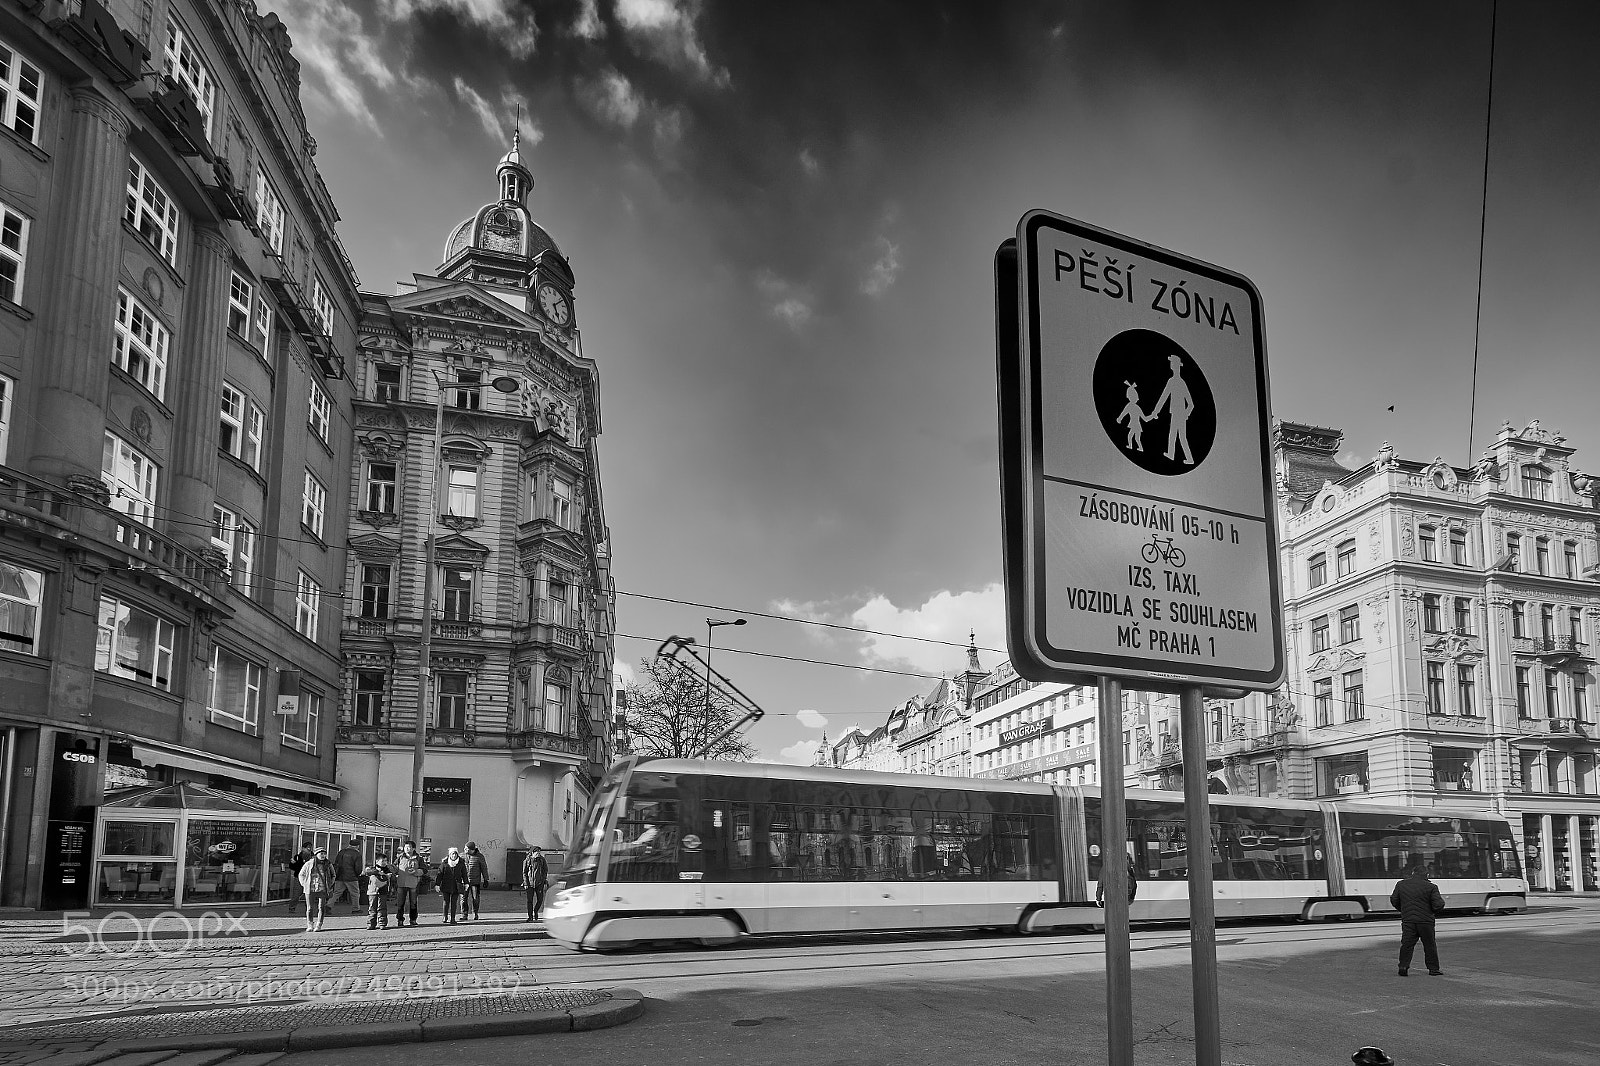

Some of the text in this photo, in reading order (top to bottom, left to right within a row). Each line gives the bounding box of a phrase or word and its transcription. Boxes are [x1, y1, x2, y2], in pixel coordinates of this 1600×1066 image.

[1054, 248, 1240, 336] PĚŠÍ ZÓNA
[1079, 493, 1240, 545] ZÁSOBOVÁNÍ 05-10 h
[1128, 564, 1201, 597] IZS, TAXI,
[1066, 586, 1258, 633] VOZIDLA SE SOUHLASEM
[1117, 621, 1216, 658] MČ PRAHA 1
[1002, 729, 1018, 742] VAN
[1075, 746, 1091, 756] SALE
